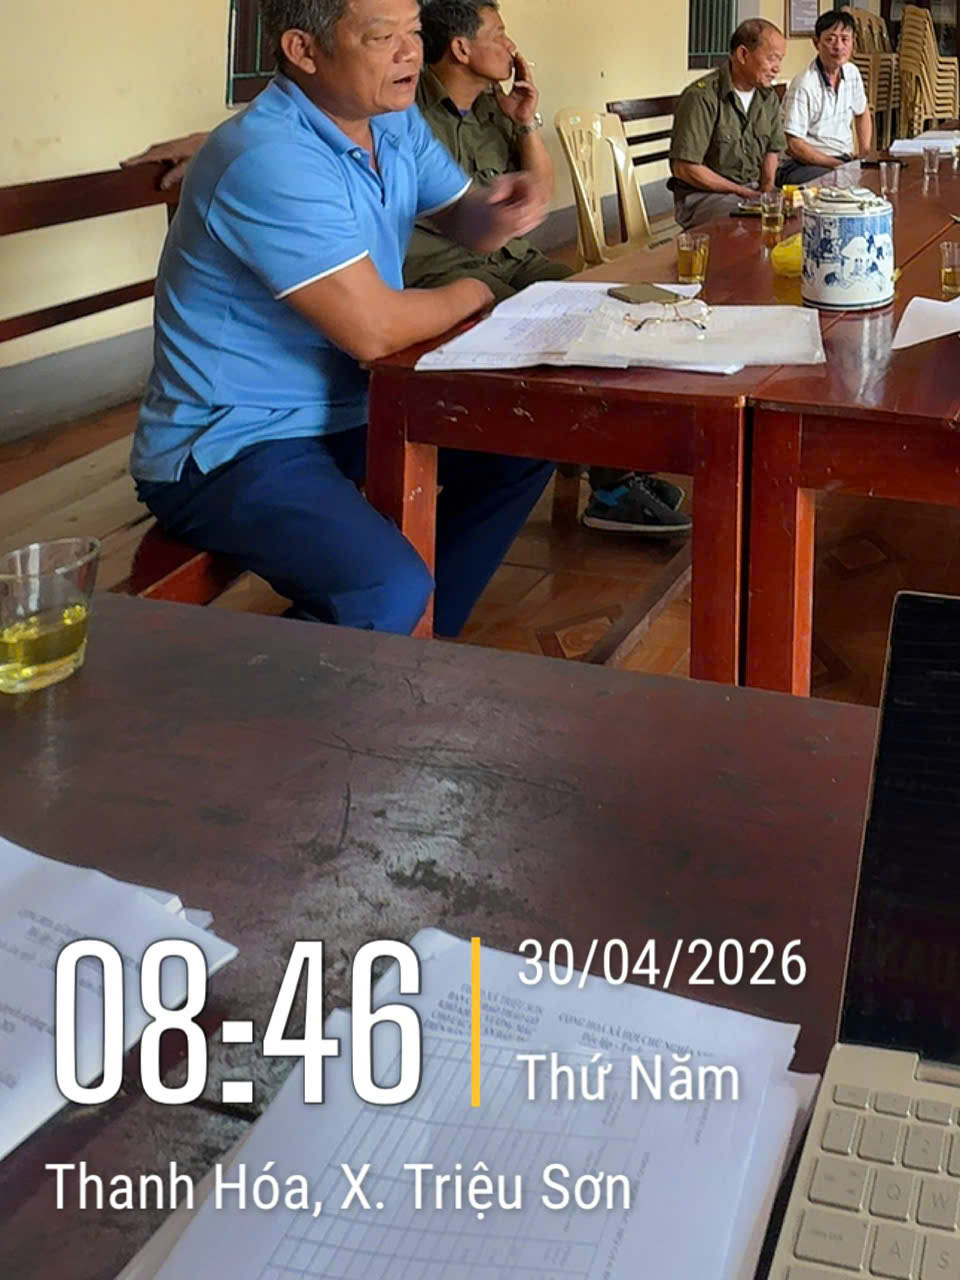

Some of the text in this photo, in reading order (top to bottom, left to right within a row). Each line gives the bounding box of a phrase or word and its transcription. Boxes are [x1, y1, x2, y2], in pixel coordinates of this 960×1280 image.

[932, 1192, 948, 1209] W
[888, 1241, 902, 1260] A
[937, 1250, 950, 1270] S
